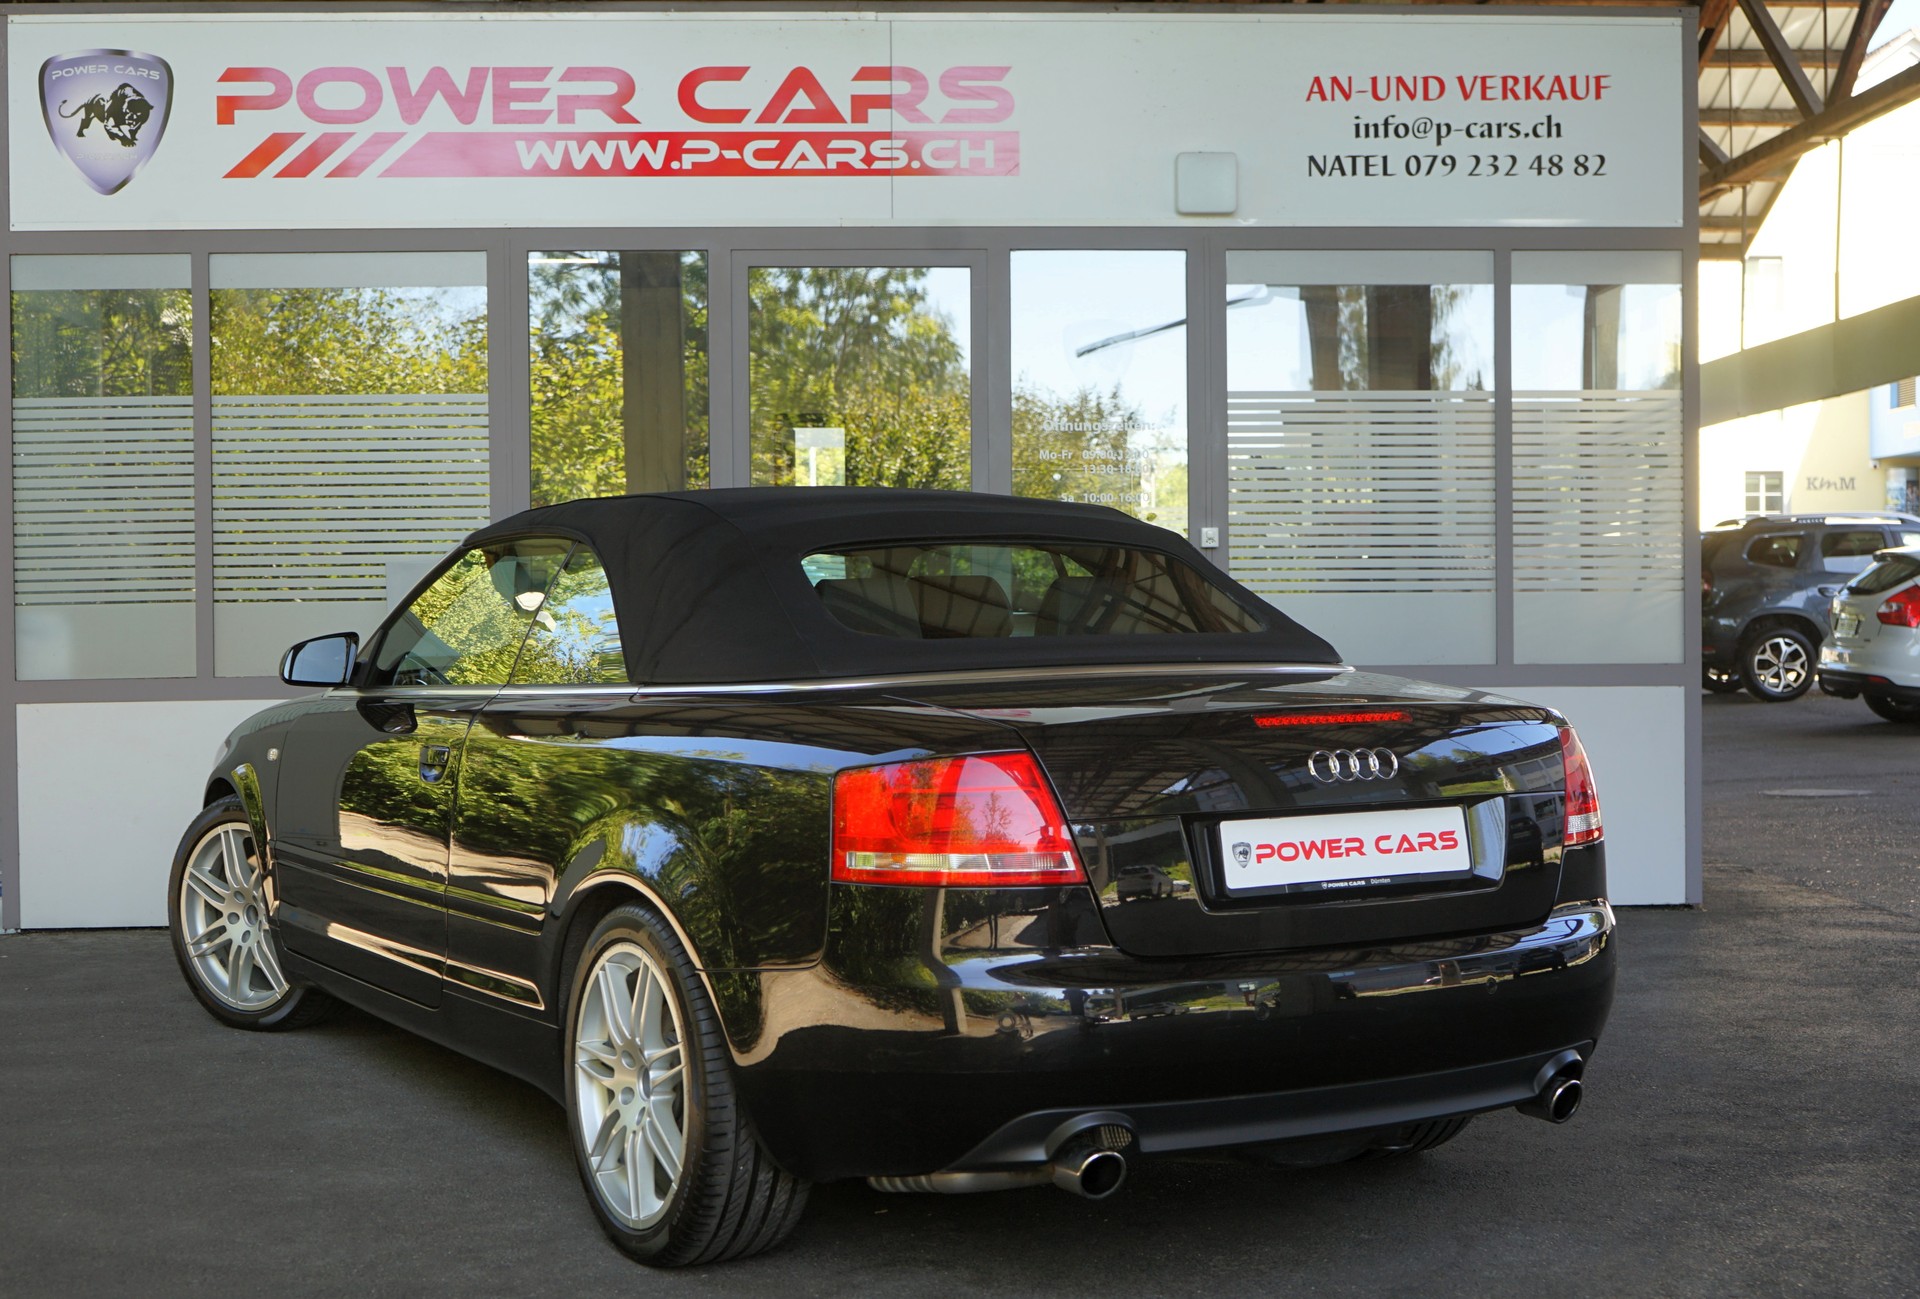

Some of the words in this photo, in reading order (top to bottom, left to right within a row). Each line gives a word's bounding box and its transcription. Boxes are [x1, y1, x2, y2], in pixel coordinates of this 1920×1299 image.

[52, 64, 109, 80] POWER
[114, 65, 161, 80] CARS
[216, 66, 641, 125] POWER
[677, 66, 1016, 125] CARS
[1305, 75, 1446, 102] AN-UND
[1456, 74, 1612, 101] VERKAUF
[1353, 114, 1563, 147] info@p-cars.ch
[515, 140, 995, 170] WWW.P-CARS.CH
[1307, 154, 1397, 177] NATEL
[1404, 154, 1457, 177] 079
[1467, 154, 1520, 177] 232
[1528, 154, 1563, 176] 48
[1573, 154, 1608, 176] 82
[1255, 837, 1367, 864] POWER
[1374, 830, 1459, 855] CARS
